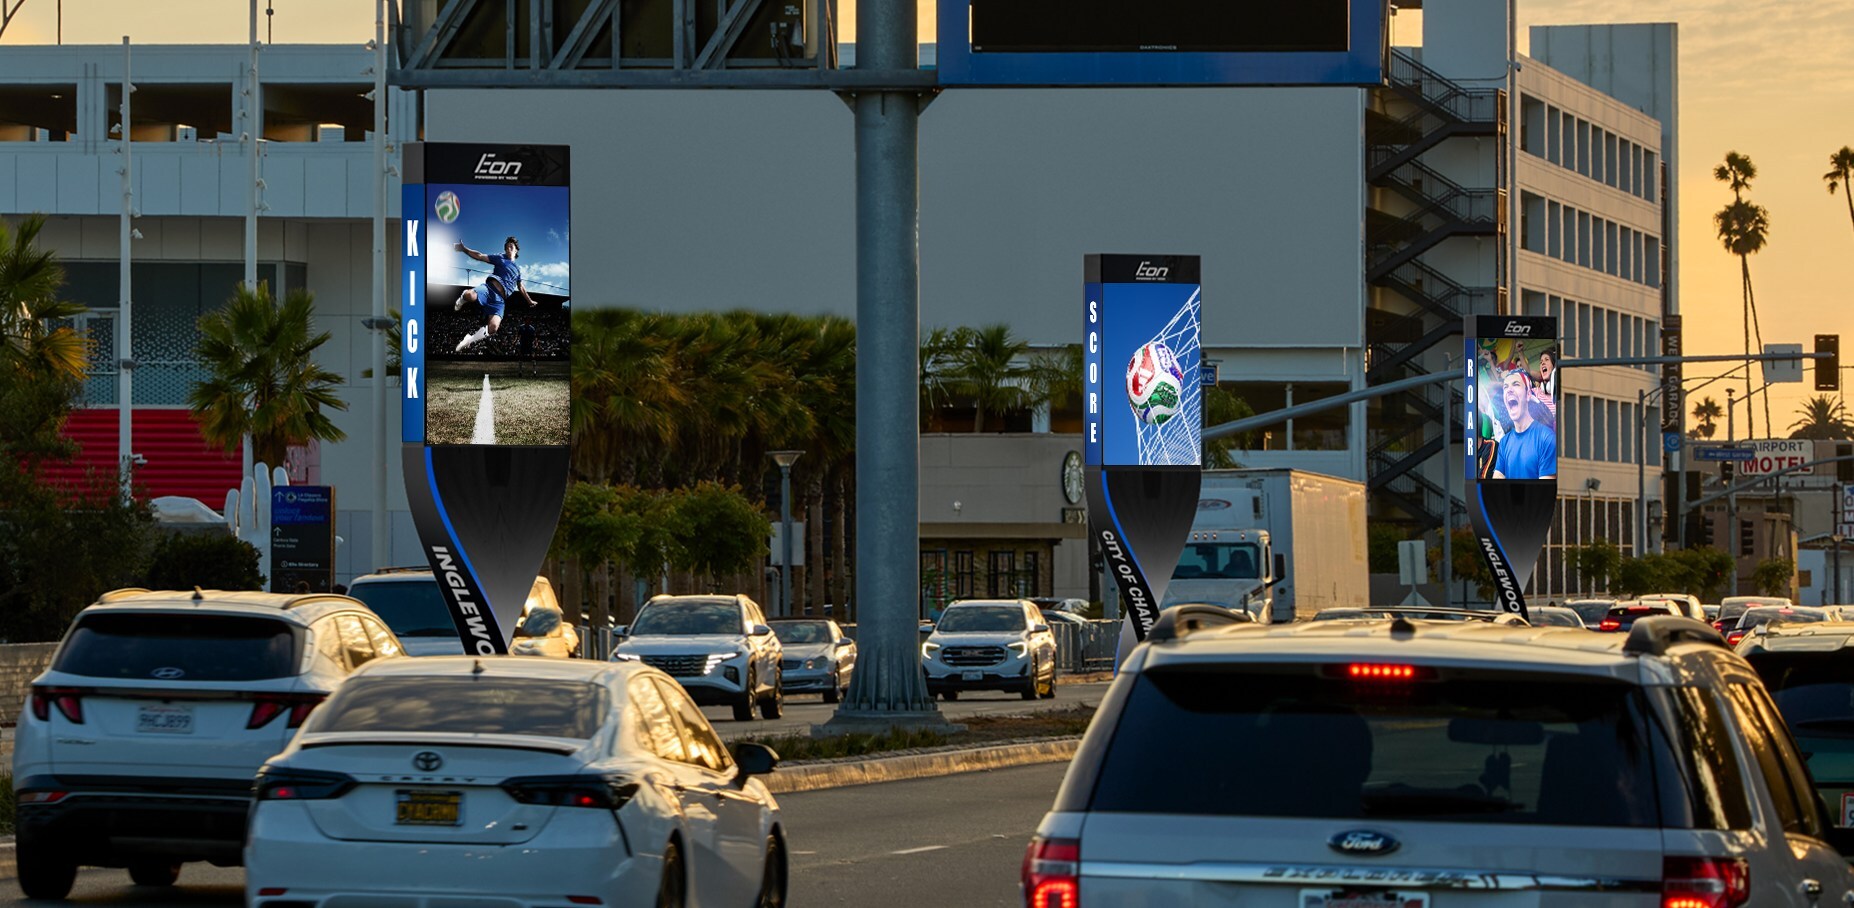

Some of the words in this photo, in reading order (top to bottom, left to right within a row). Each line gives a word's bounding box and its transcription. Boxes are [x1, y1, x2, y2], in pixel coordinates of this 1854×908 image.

[474, 153, 522, 175] Eon
[1136, 261, 1168, 277] Eon
[406, 219, 419, 399] KICK
[1504, 321, 1531, 334] Eon
[1668, 336, 1678, 372] WET
[1089, 301, 1098, 443] SCORE
[1751, 441, 1804, 452] AIRPORT
[1744, 456, 1811, 473] MOTEL
[1102, 530, 1126, 561] CITY
[1117, 564, 1138, 584] OF
[1128, 586, 1154, 636] CHAM
[1481, 537, 1521, 614] INGLEWOO
[1342, 831, 1383, 850] Ford
[1263, 866, 1466, 883] EXPLORER
